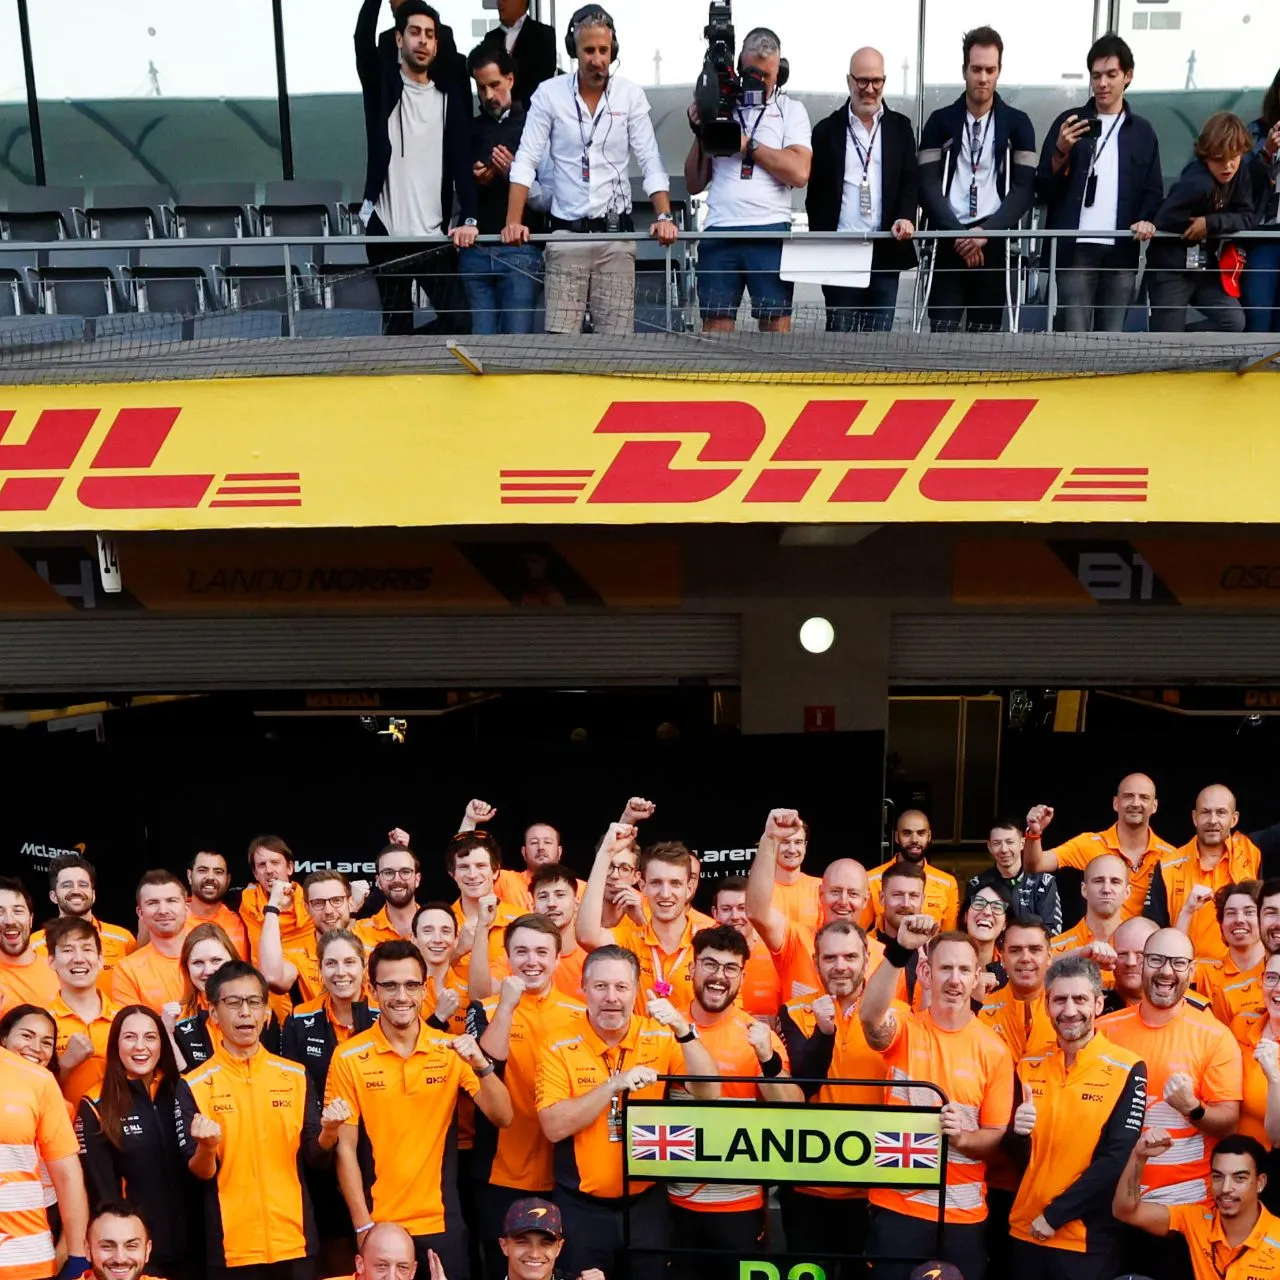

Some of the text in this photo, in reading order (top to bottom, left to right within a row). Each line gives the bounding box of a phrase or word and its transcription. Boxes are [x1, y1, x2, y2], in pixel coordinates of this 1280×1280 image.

[586, 398, 1062, 504] DHL
[101, 539, 120, 575] 14
[187, 565, 433, 595] LANDO NORRIS
[695, 1127, 871, 1167] LANDO
